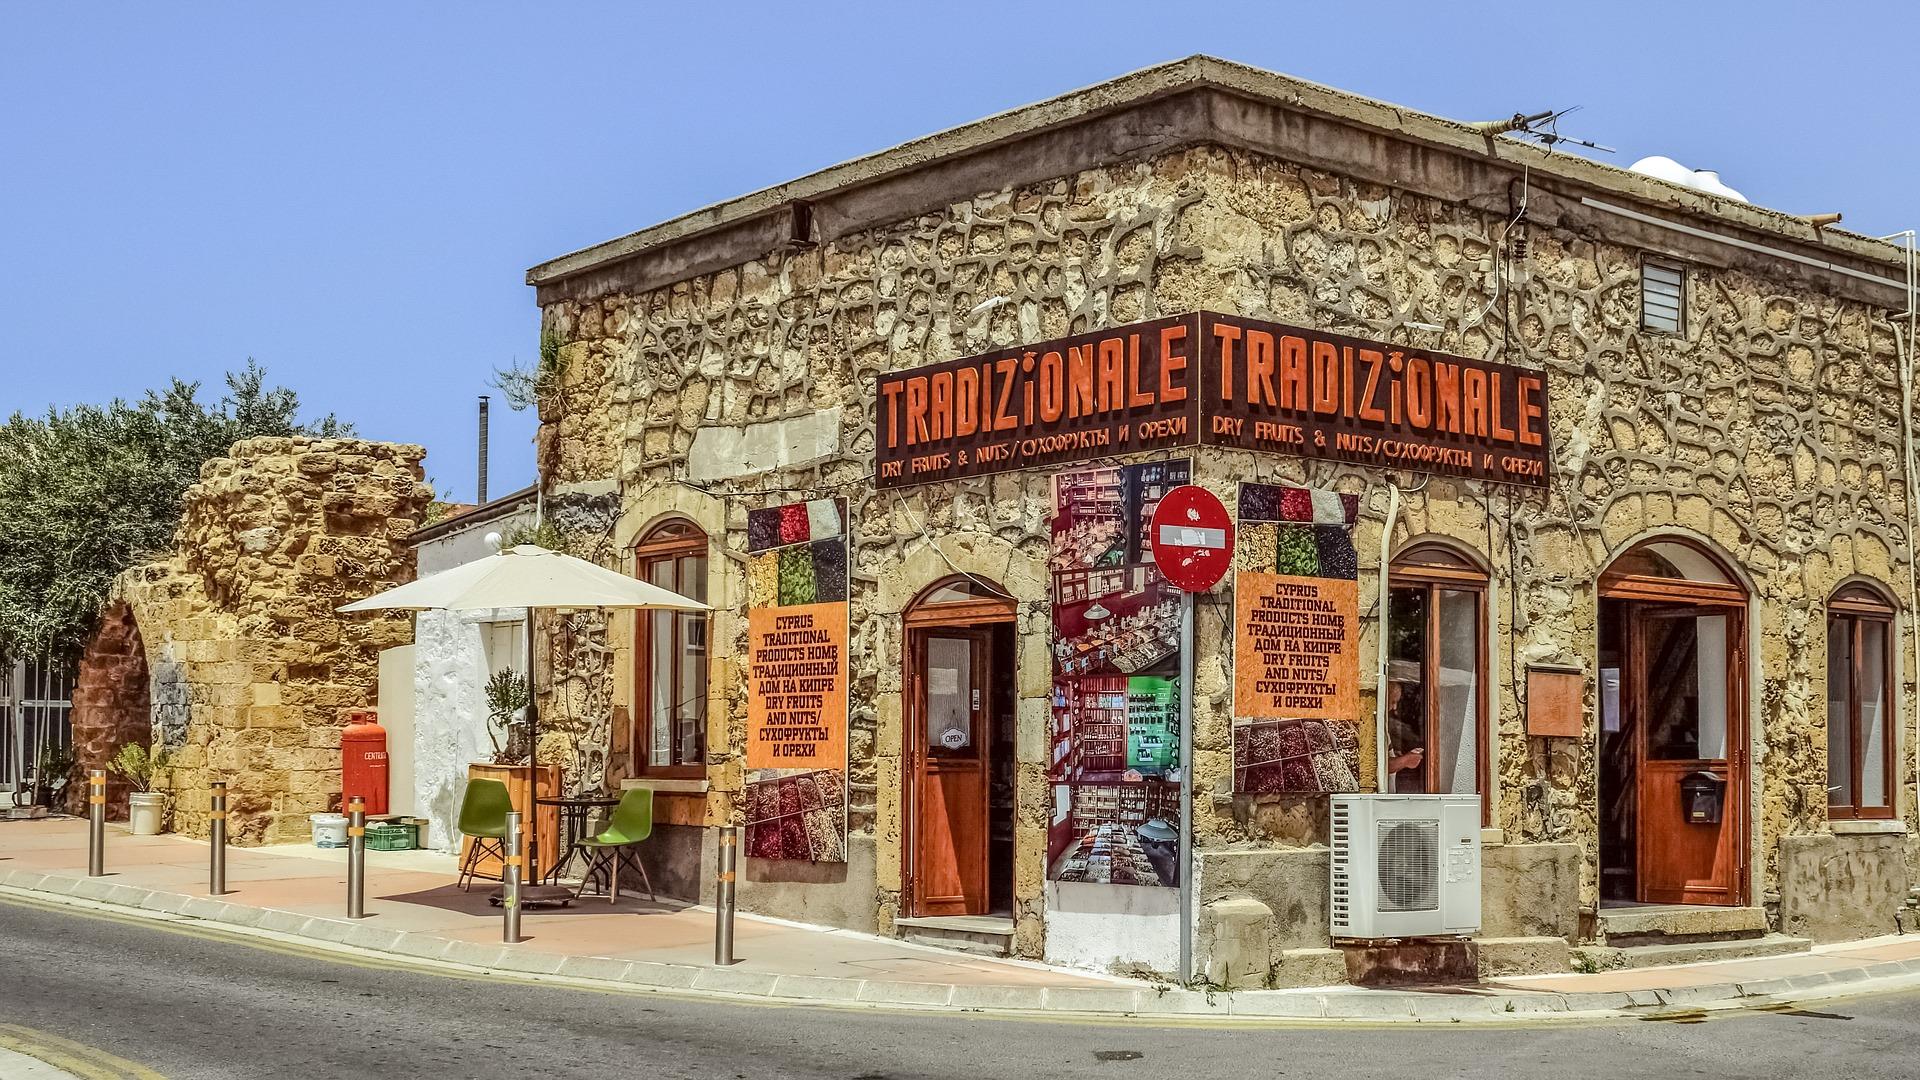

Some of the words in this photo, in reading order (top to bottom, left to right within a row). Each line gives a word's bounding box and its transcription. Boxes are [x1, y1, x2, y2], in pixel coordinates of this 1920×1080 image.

[882, 460, 904, 478] DRY
[912, 452, 950, 474] FRUITS
[958, 451, 968, 465] &
[1118, 425, 1129, 441] И
[1139, 417, 1186, 440] ОРЕХИ
[1213, 416, 1243, 436] DRY
[1255, 421, 1304, 444] FRUITS
[1314, 430, 1326, 447] &
[1483, 454, 1493, 469] И
[1502, 455, 1543, 476] ОРЕХИ
[1276, 583, 1317, 597] CYPRUS
[1260, 596, 1336, 612] TRADITIONAL
[776, 615, 813, 630] CYPRUS
[1251, 610, 1308, 624] PRODUCTS
[1312, 614, 1344, 627] HOME
[763, 630, 830, 646] TRADITIONAL
[1247, 624, 1345, 640] ТРАДИЦИОННЫЙ
[757, 648, 804, 662] PRODUCTS
[808, 645, 838, 660] HOME
[1254, 639, 1280, 652] ДОМ
[1284, 640, 1300, 652] НА
[1304, 641, 1341, 654] КИПРЕ
[1263, 653, 1286, 665] DRY
[1289, 655, 1329, 667] FRUITS
[753, 658, 838, 679] ТРАДИЦИОННЫЙ
[1265, 667, 1289, 679] AND
[1293, 669, 1328, 682] NUTS/
[759, 680, 780, 696] ДОМ
[783, 680, 796, 693] НА
[799, 678, 834, 692] КИПРЕ
[1256, 681, 1336, 695] СУХОФРУКТЫ
[766, 696, 784, 709] DRY
[787, 695, 822, 708] FRUITS
[1273, 696, 1281, 707] И
[1286, 696, 1323, 708] ОРЕХИ
[767, 712, 786, 725] AND
[790, 710, 821, 725] NUTS/
[760, 727, 828, 740] СУХОФРУКТЫ
[773, 744, 780, 756] И
[783, 744, 816, 756] ОРЕХИ
